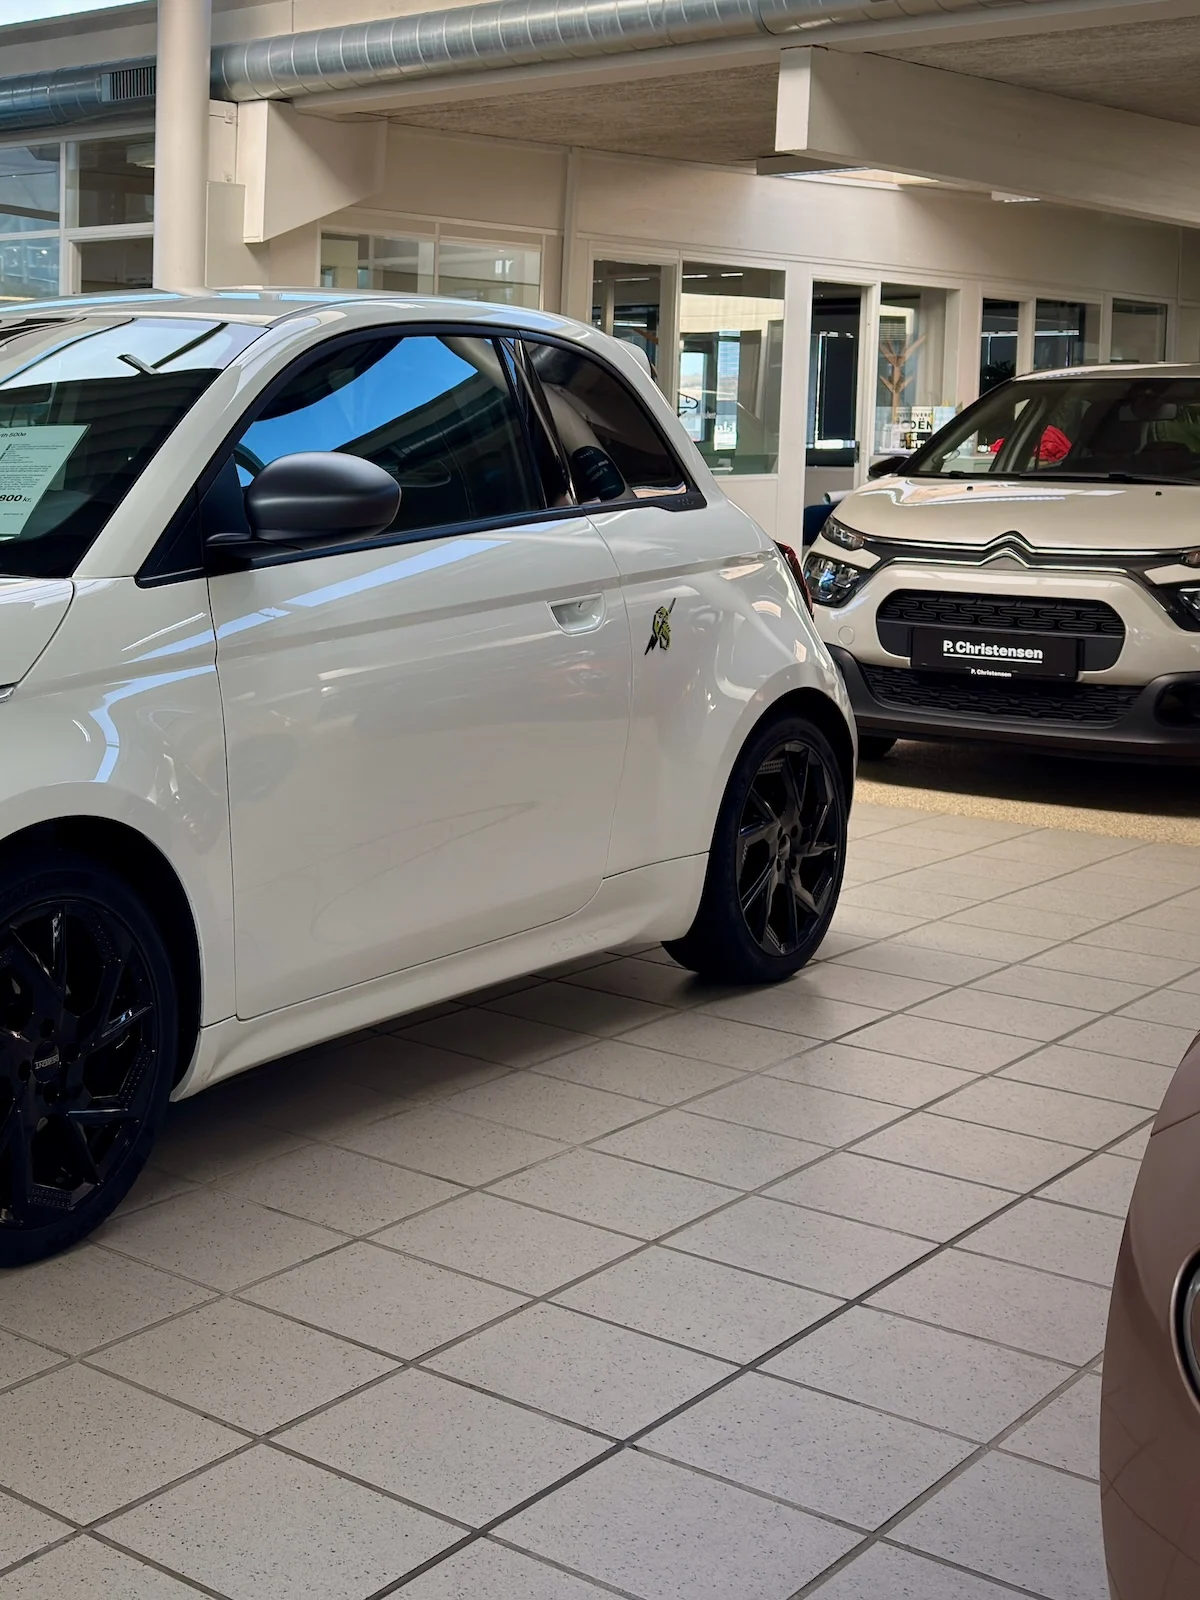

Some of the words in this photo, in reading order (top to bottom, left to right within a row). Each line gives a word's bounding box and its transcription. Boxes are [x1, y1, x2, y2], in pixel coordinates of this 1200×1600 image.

[943, 640, 955, 653] P.
[955, 641, 1043, 660] Christensen
[977, 669, 1012, 678] Christensen
